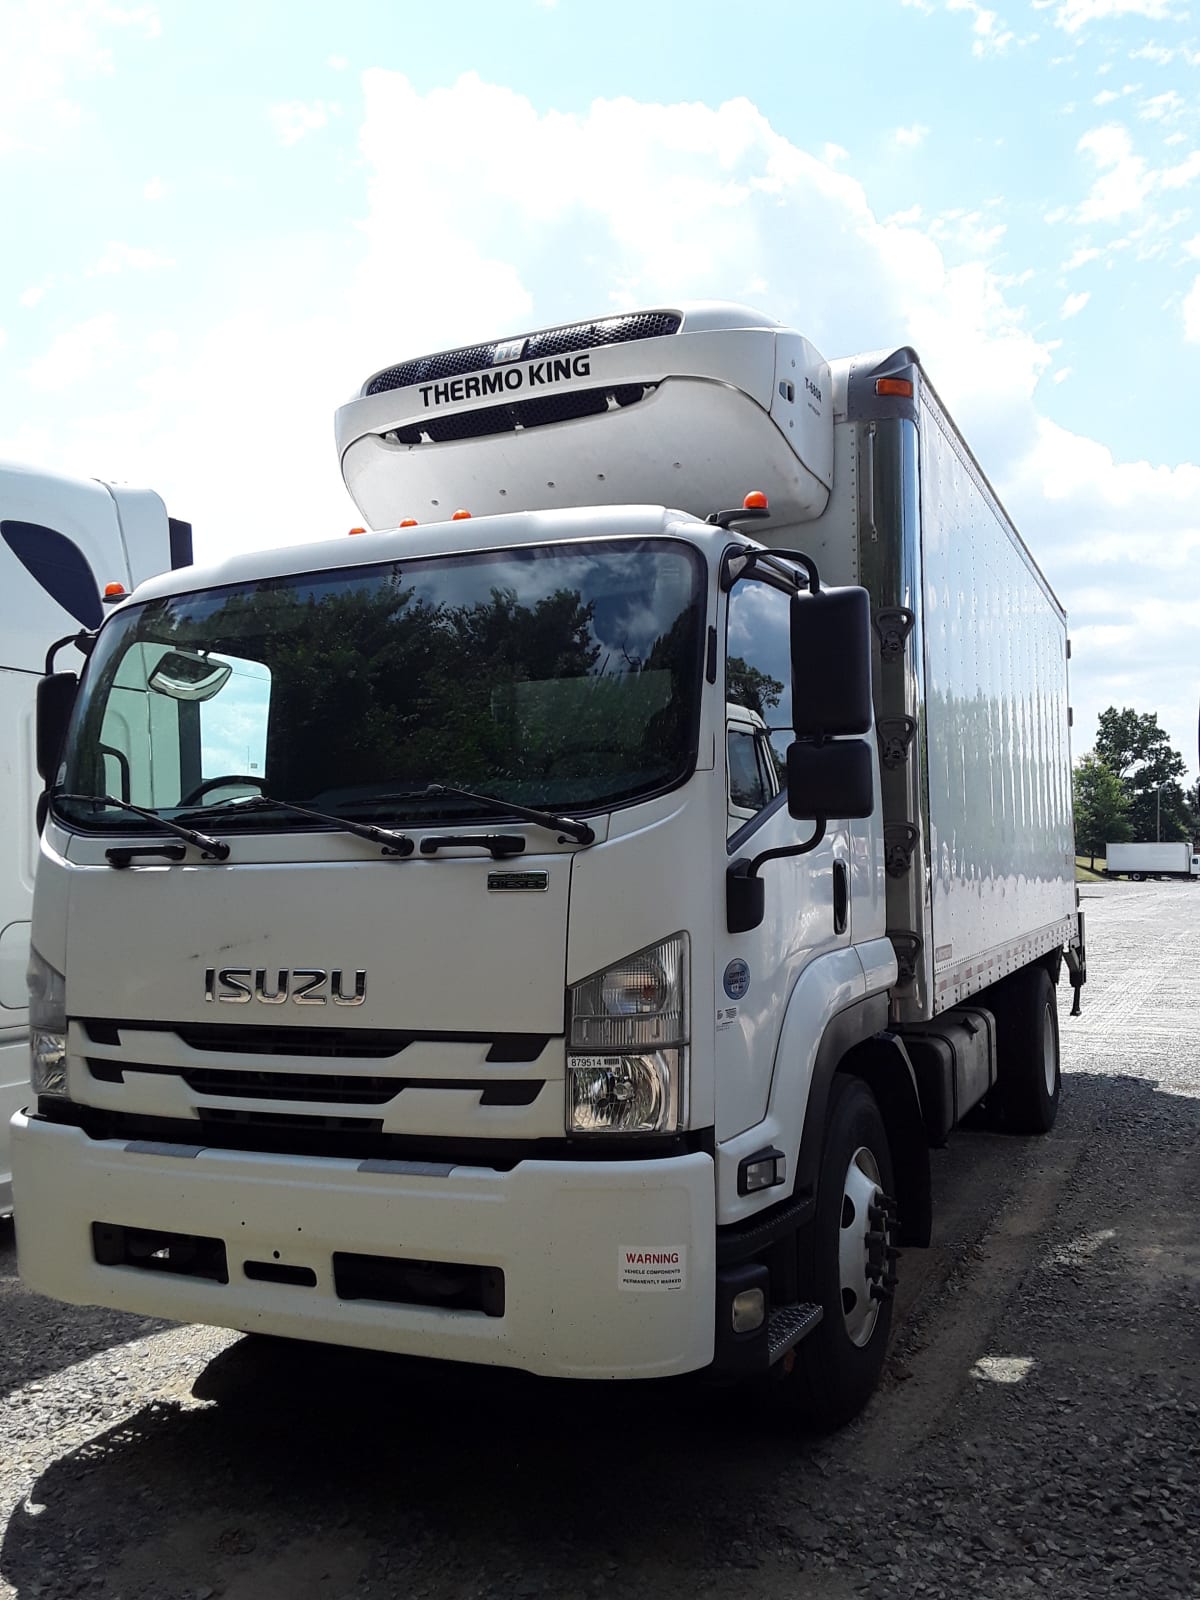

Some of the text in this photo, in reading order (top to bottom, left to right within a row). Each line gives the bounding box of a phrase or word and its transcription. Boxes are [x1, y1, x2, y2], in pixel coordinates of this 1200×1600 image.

[418, 354, 591, 407] THERMO KING
[205, 967, 367, 1006] ISUZU
[571, 1058, 602, 1067] 879514
[625, 1252, 679, 1265] WARNING
